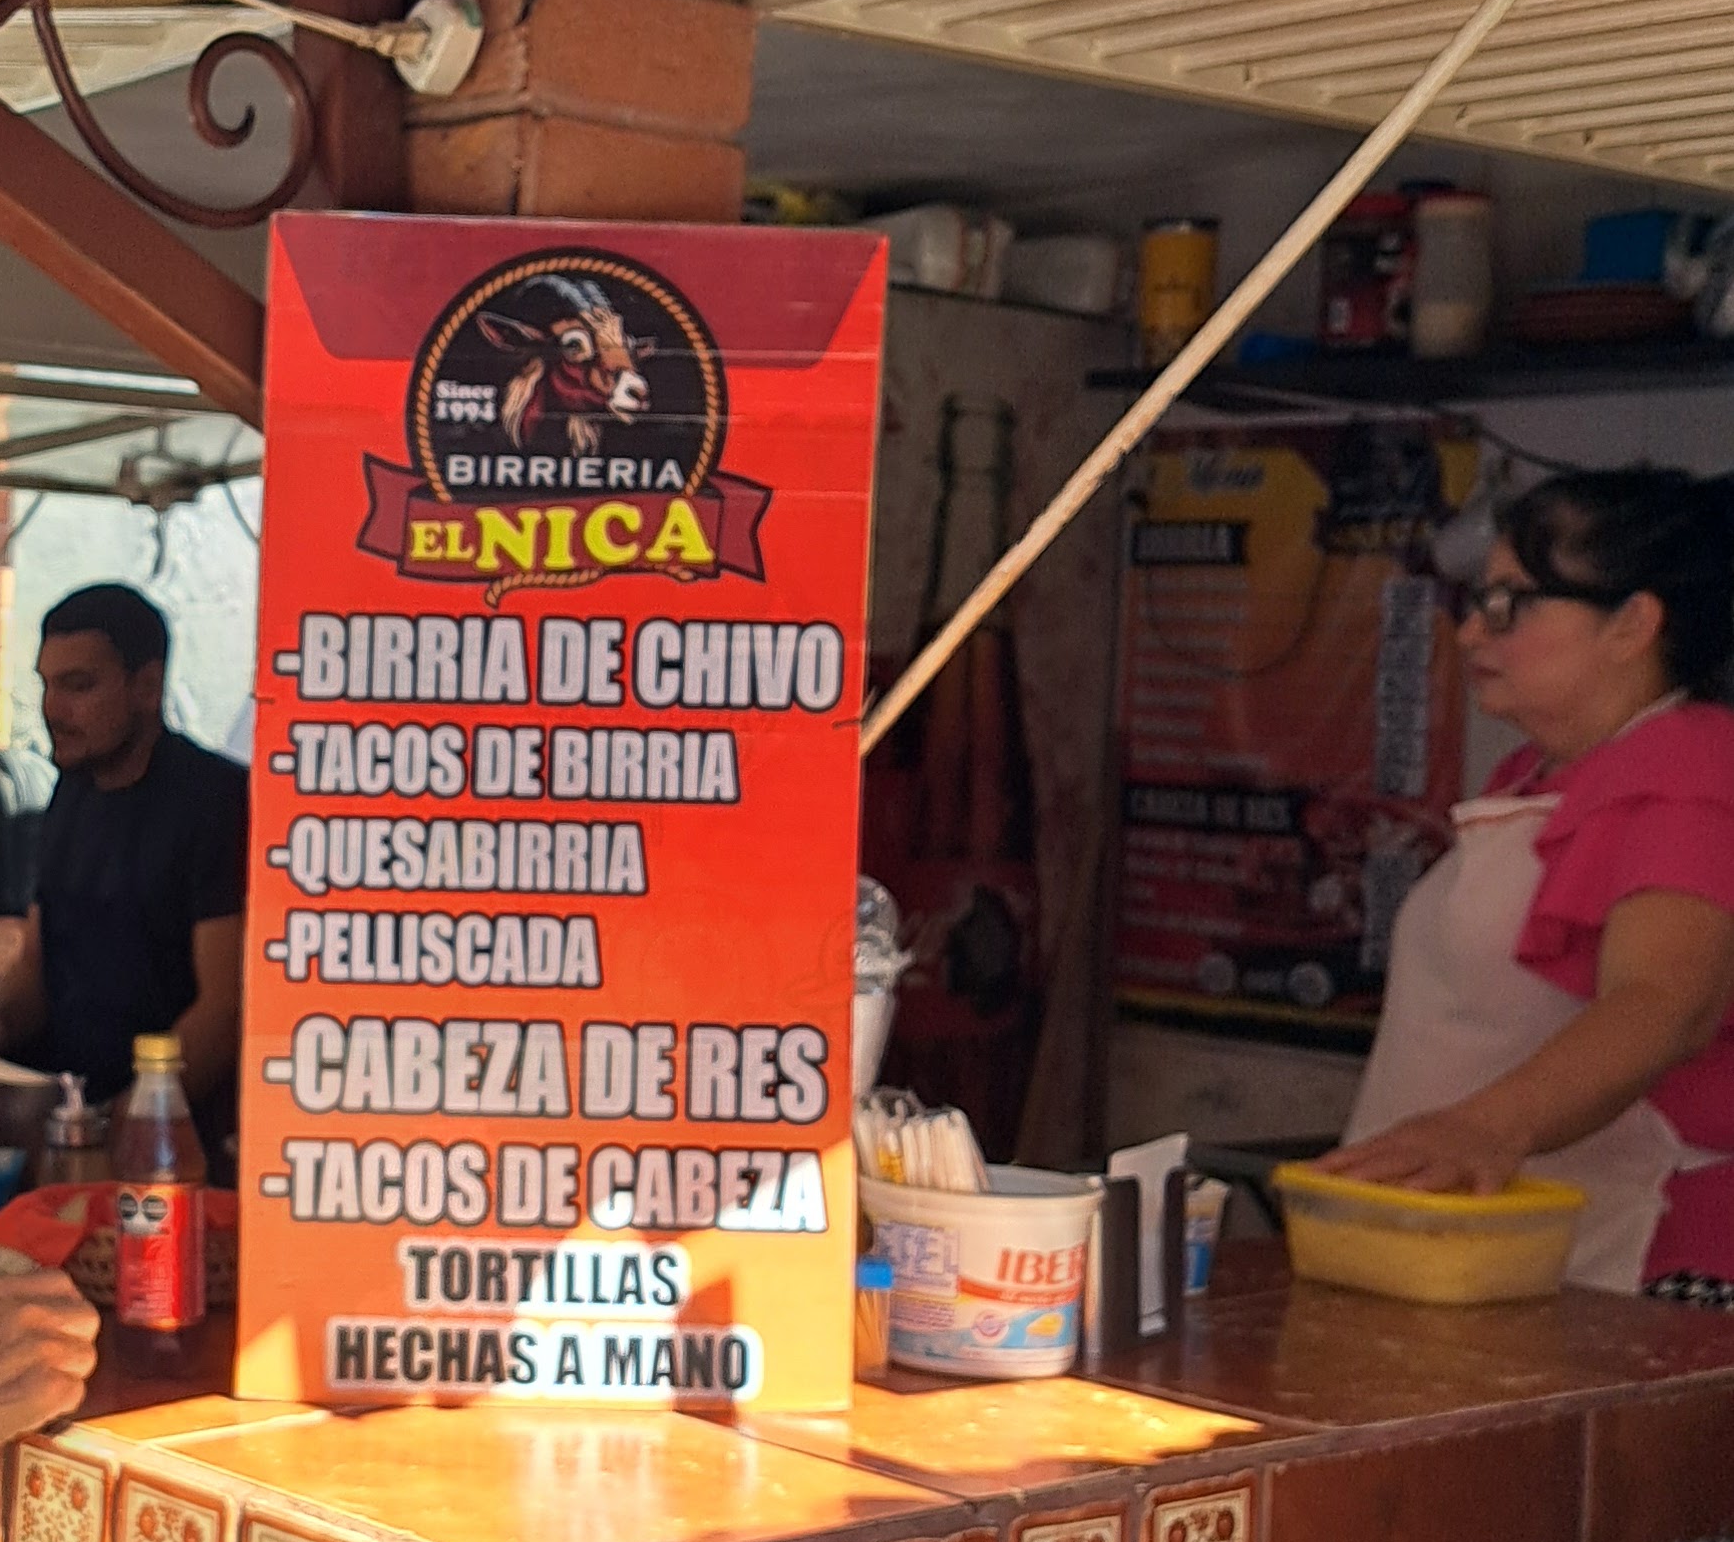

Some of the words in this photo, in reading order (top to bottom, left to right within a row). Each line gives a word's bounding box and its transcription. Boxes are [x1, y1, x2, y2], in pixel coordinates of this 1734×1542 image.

[435, 400, 497, 423] 1994
[436, 380, 497, 400] Since
[444, 454, 686, 492] BIRRIERIA
[410, 519, 473, 562] EL
[475, 498, 714, 571] NICA
[539, 618, 624, 706] DE
[634, 621, 844, 713] CHIVO
[473, 726, 545, 798] DE
[551, 729, 740, 802] BIRRIA
[580, 1021, 677, 1120] DE
[686, 1024, 828, 1124] RES
[496, 1144, 579, 1227] DE
[587, 1147, 829, 1232] CABEZA
[403, 1243, 683, 1307] TORTILLAS
[332, 1323, 539, 1385] HECHAS
[553, 1330, 586, 1387] A
[601, 1332, 752, 1392] MANO
